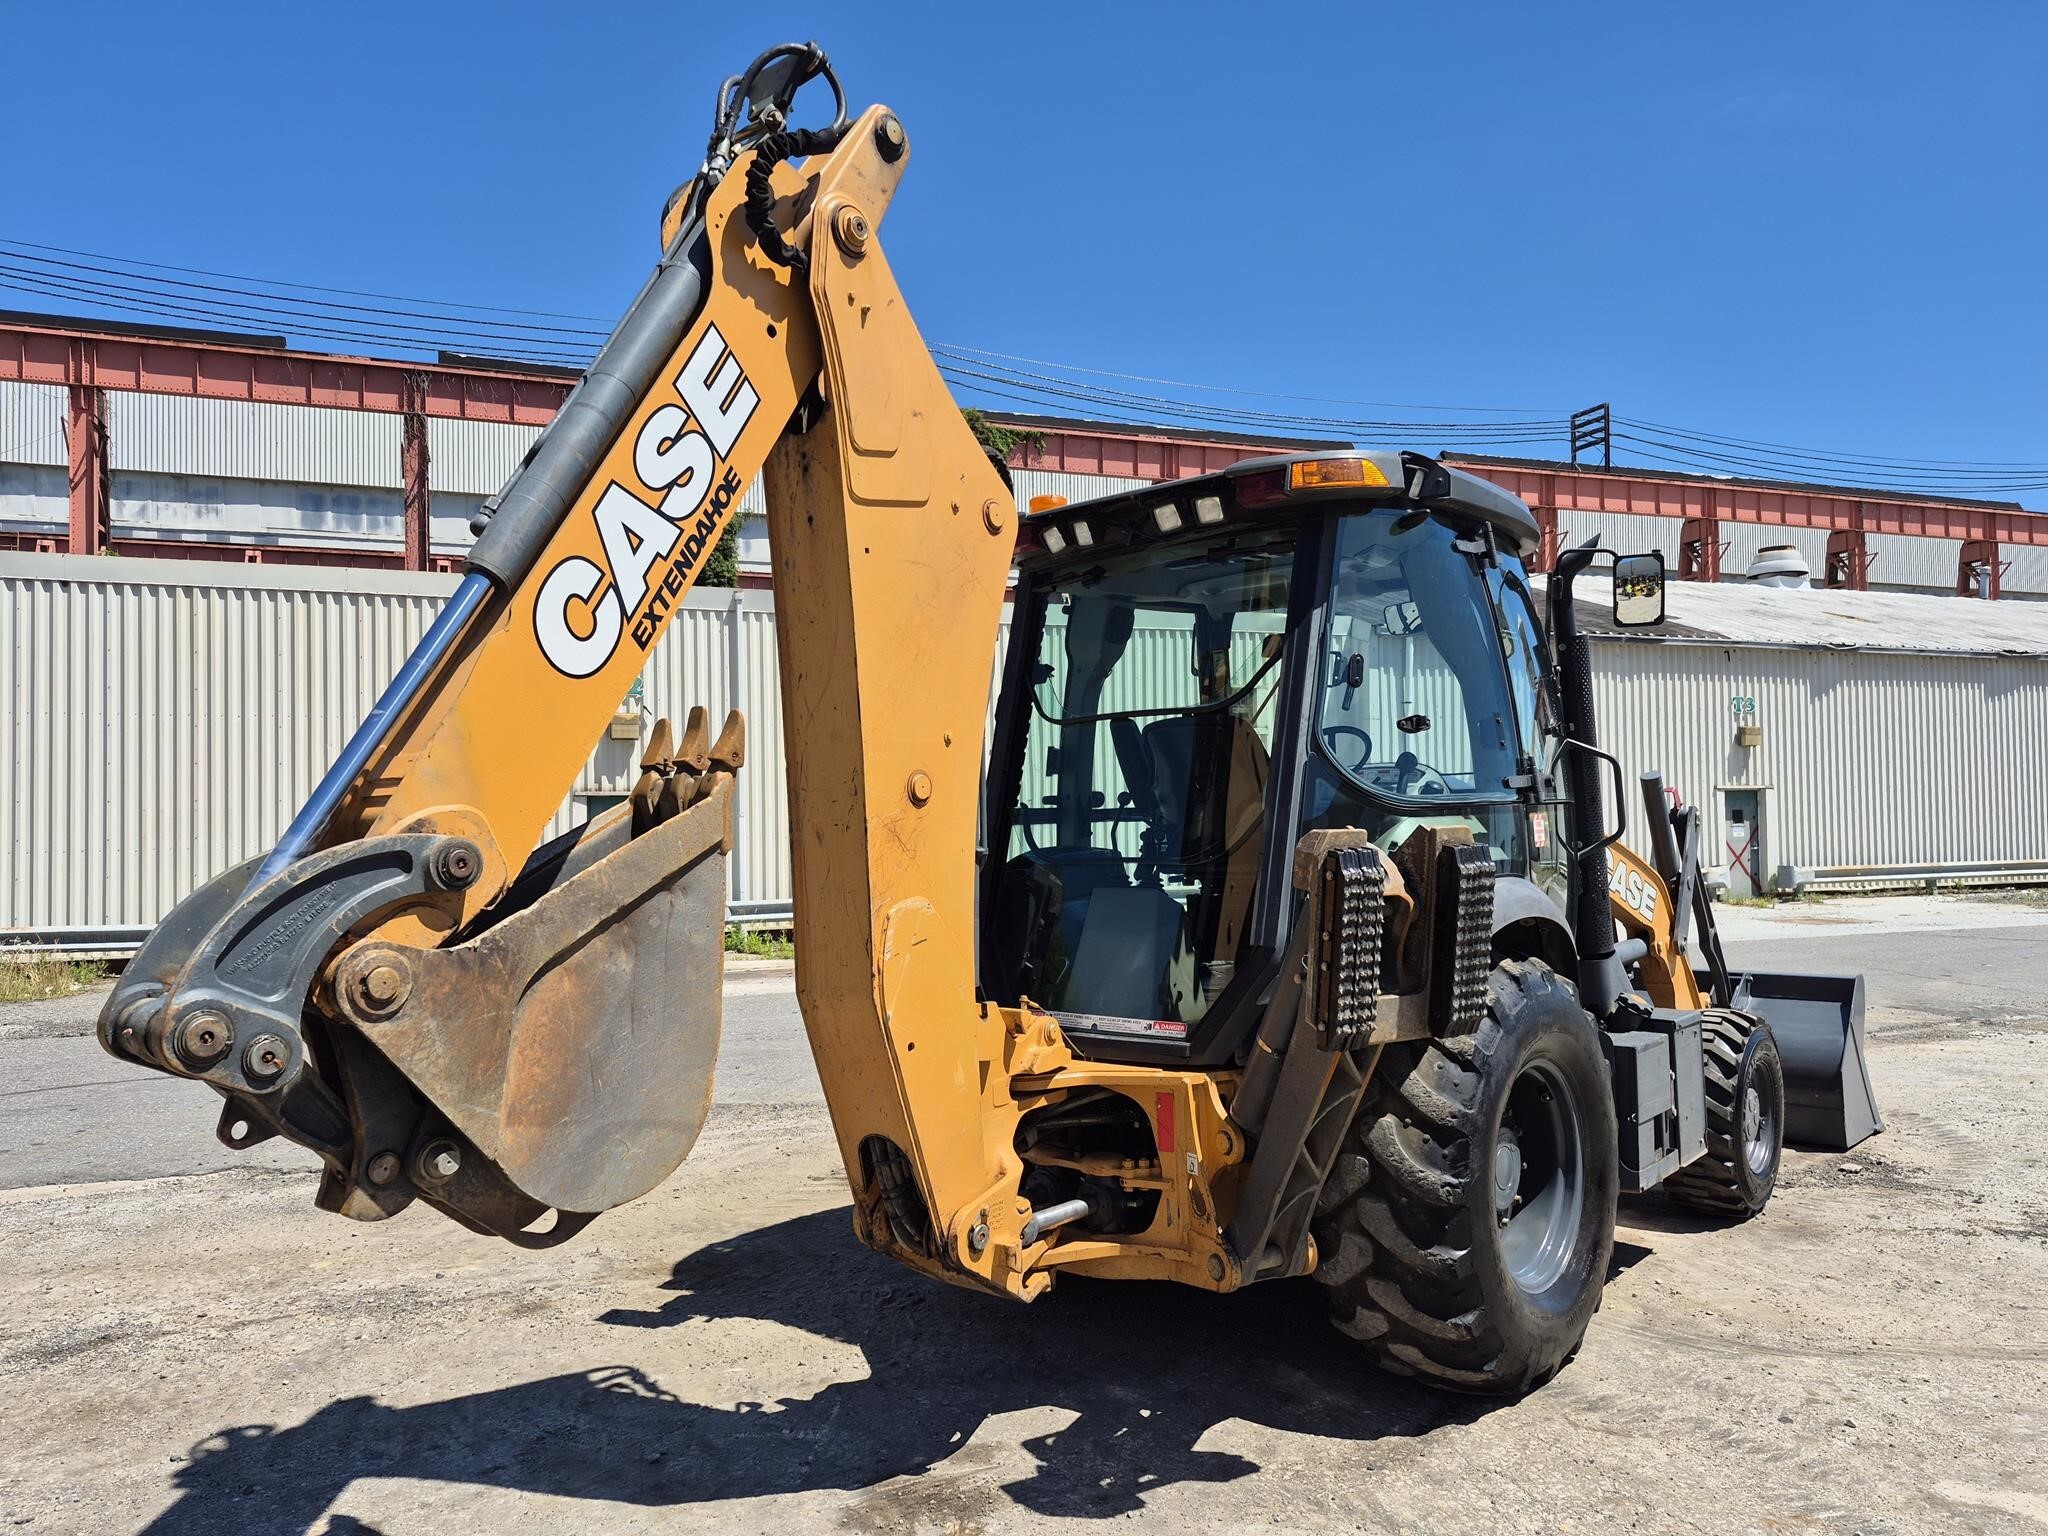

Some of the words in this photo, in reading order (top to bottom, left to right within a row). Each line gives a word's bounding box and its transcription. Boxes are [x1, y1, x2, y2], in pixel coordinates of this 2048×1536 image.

[533, 320, 761, 679] CASE
[631, 466, 742, 651] EXTENDAHOE
[1731, 696, 1756, 713] T3
